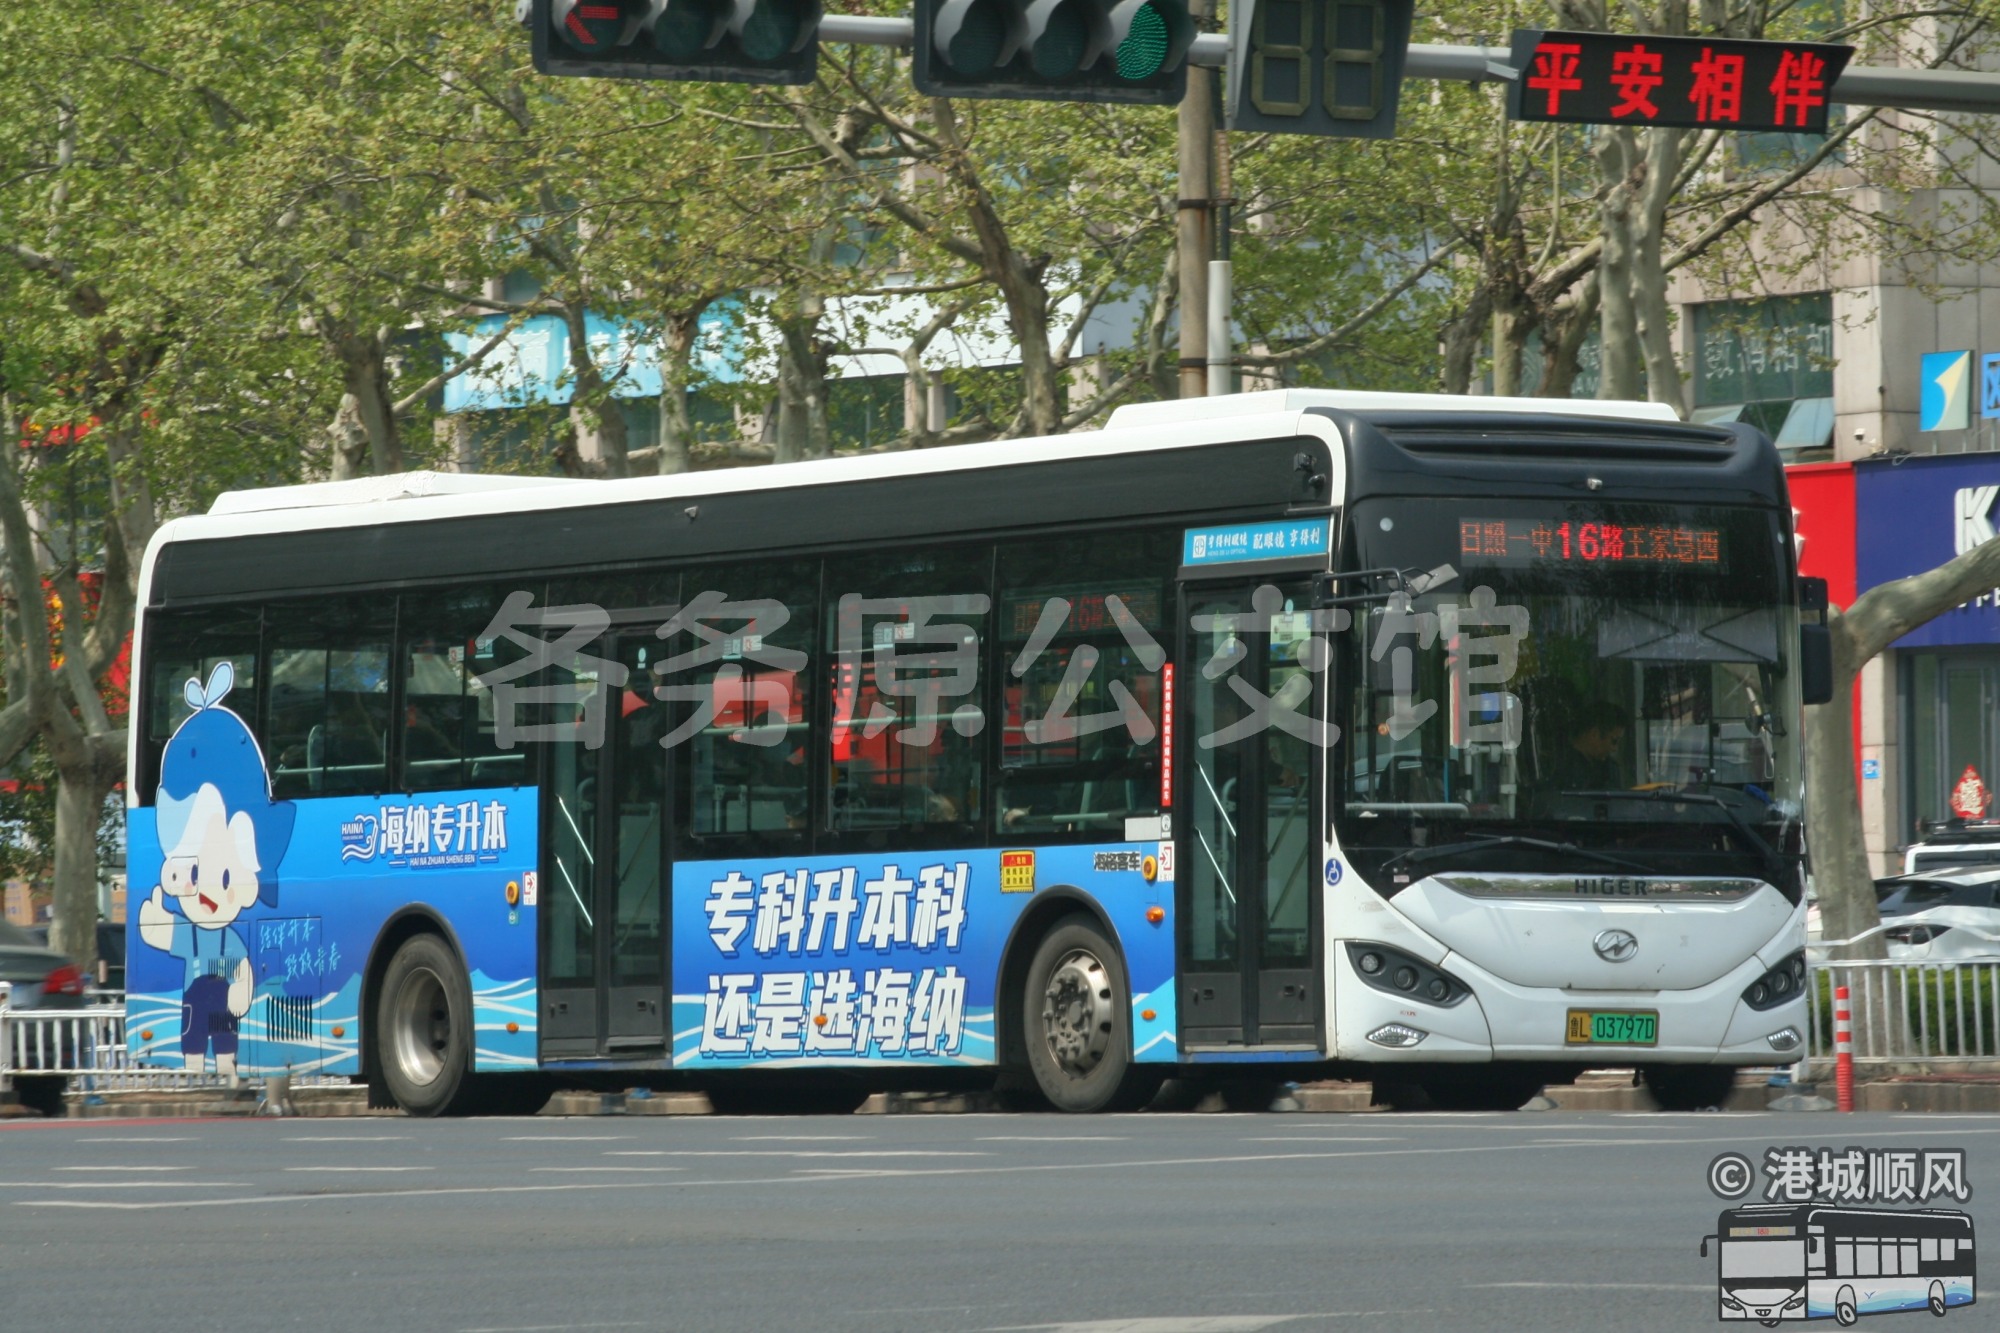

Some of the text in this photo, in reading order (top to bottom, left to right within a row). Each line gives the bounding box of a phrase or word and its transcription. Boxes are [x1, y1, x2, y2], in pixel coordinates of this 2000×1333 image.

[1527, 43, 1826, 127] 平安相伴
[1253, 532, 1285, 549] 配眼镜
[1290, 527, 1321, 547] 亨得利
[1557, 522, 1626, 560] 16路
[341, 822, 364, 835] HAINA
[380, 800, 507, 855] 海纳专升本
[427, 855, 446, 866] ZHUAN
[446, 854, 464, 865] SHENG
[464, 853, 476, 863] BEN
[1095, 851, 1141, 871] 海格客车
[1574, 878, 1648, 896] HIGER
[704, 861, 971, 954] 专科升本科
[699, 966, 970, 1057] 还是选海纳
[1596, 1017, 1655, 1040] 03797D
